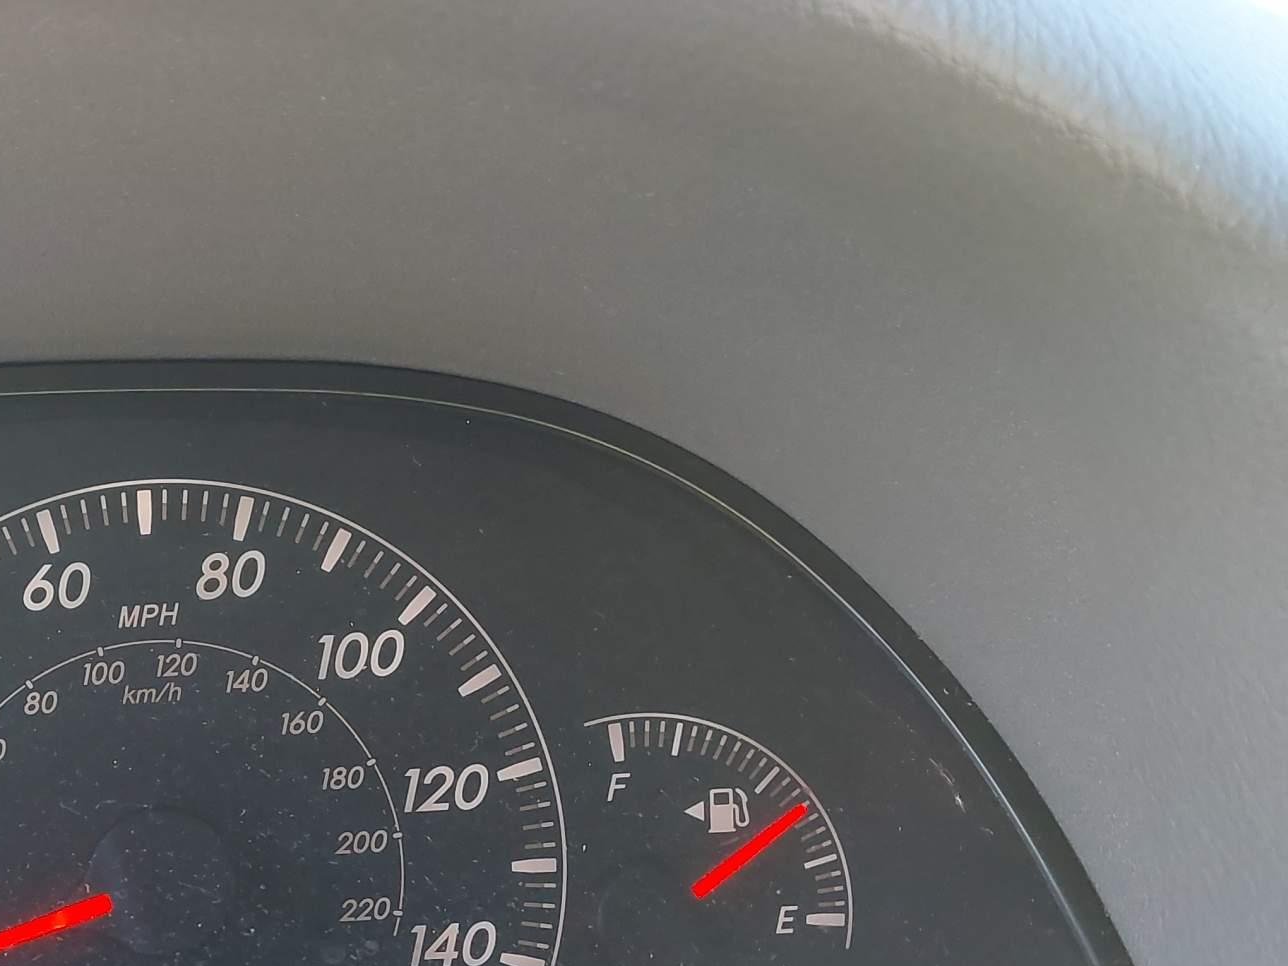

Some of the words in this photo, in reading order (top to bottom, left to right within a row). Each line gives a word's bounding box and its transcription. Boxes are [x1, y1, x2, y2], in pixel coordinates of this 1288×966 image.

[22, 562, 92, 611] 60
[195, 550, 266, 600] 80
[118, 602, 180, 629] MPH
[155, 653, 197, 677] 120
[318, 628, 405, 680] 100
[83, 660, 125, 686] 100
[225, 668, 268, 693] 140
[23, 690, 58, 715] 80
[122, 684, 182, 705] km/h
[281, 710, 324, 735] 160
[322, 766, 364, 790] 180
[404, 764, 489, 813] 120
[608, 773, 631, 801] F
[335, 830, 388, 855] 200
[339, 897, 391, 922] 220
[776, 905, 798, 934] E
